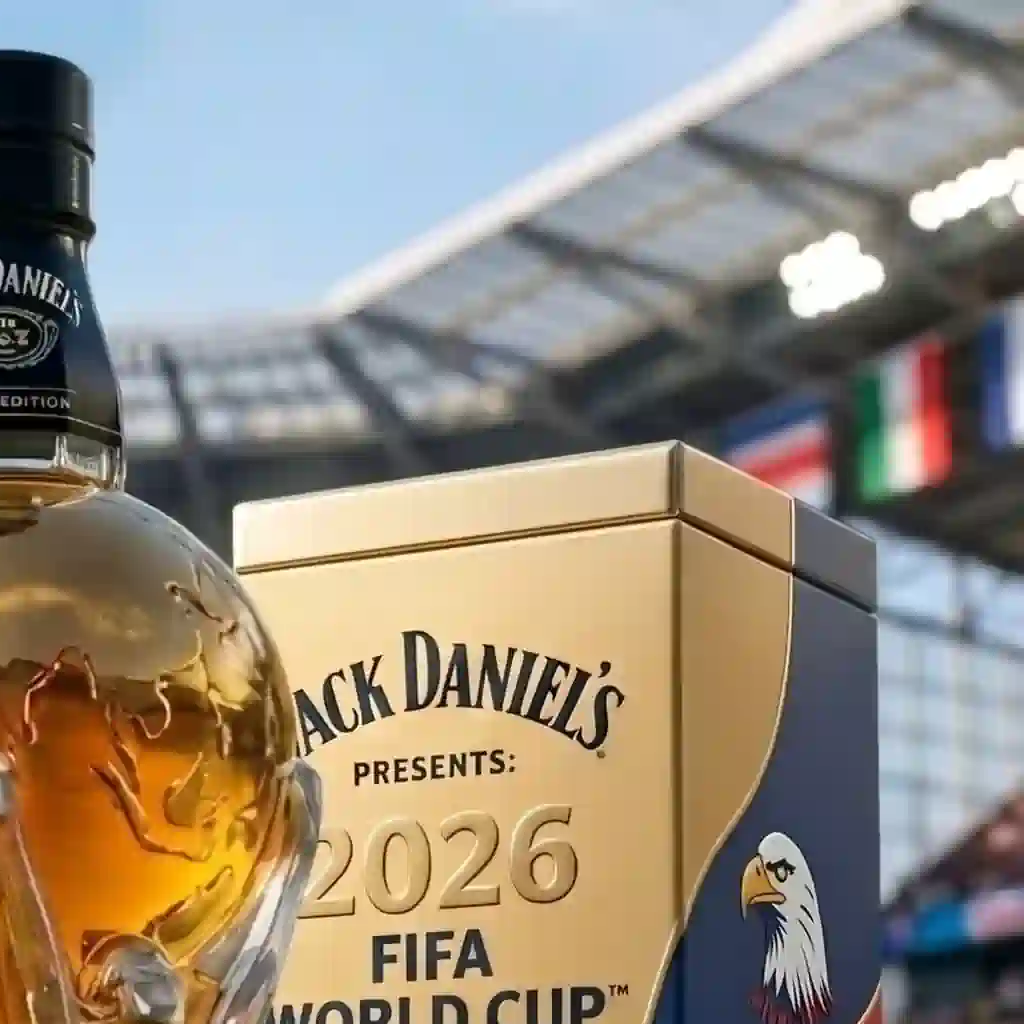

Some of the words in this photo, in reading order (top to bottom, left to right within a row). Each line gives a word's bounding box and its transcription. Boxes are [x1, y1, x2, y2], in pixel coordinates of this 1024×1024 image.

[0, 395, 71, 409] EDITION
[293, 654, 396, 757] ACK
[401, 629, 625, 751] DANIEL'S
[354, 749, 516, 786] PRESENTS:
[296, 803, 579, 920] 2026
[371, 928, 493, 983] FIFA
